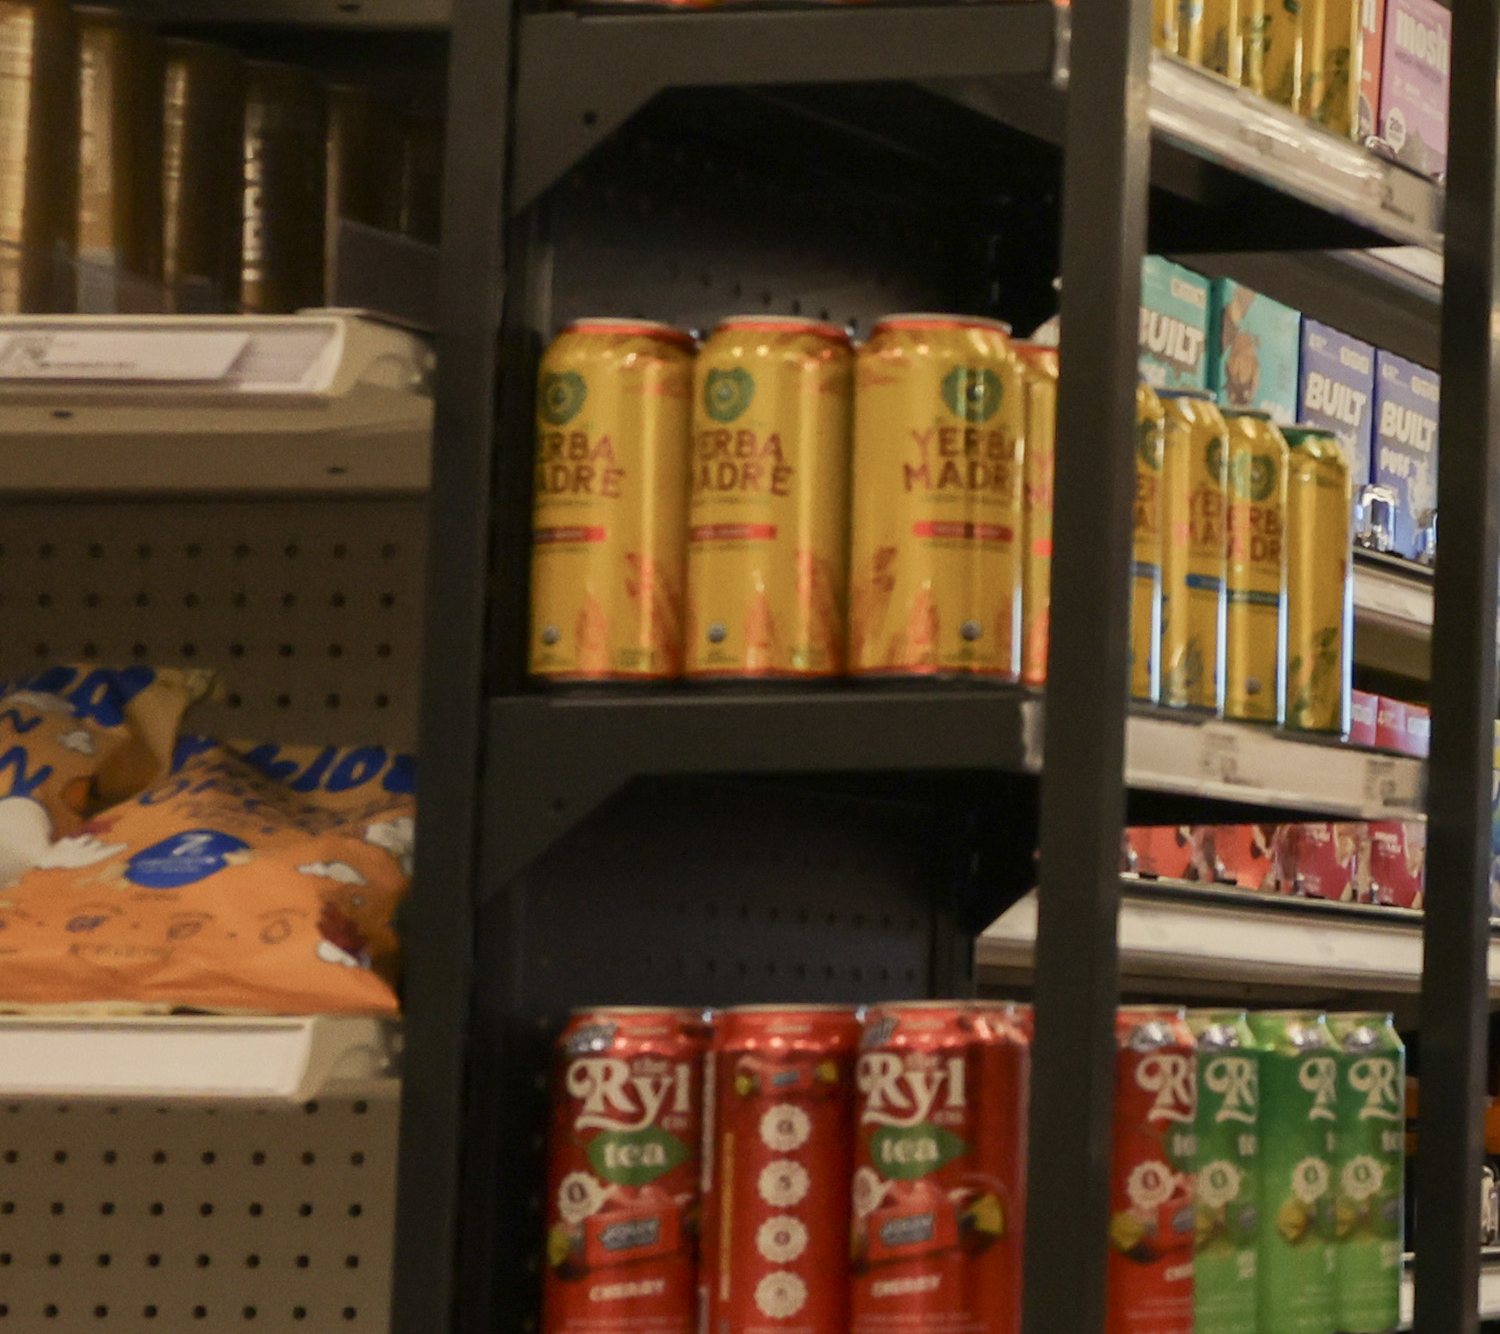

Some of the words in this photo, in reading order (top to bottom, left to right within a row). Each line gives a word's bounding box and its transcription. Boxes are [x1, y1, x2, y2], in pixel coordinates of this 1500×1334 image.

[1306, 373, 1366, 427] BUILT
[1380, 401, 1438, 453] BUILT
[568, 1058, 692, 1132] Ryl
[858, 1053, 965, 1127] Ryl
[604, 1138, 667, 1170] tea
[880, 1137, 938, 1164] tea
